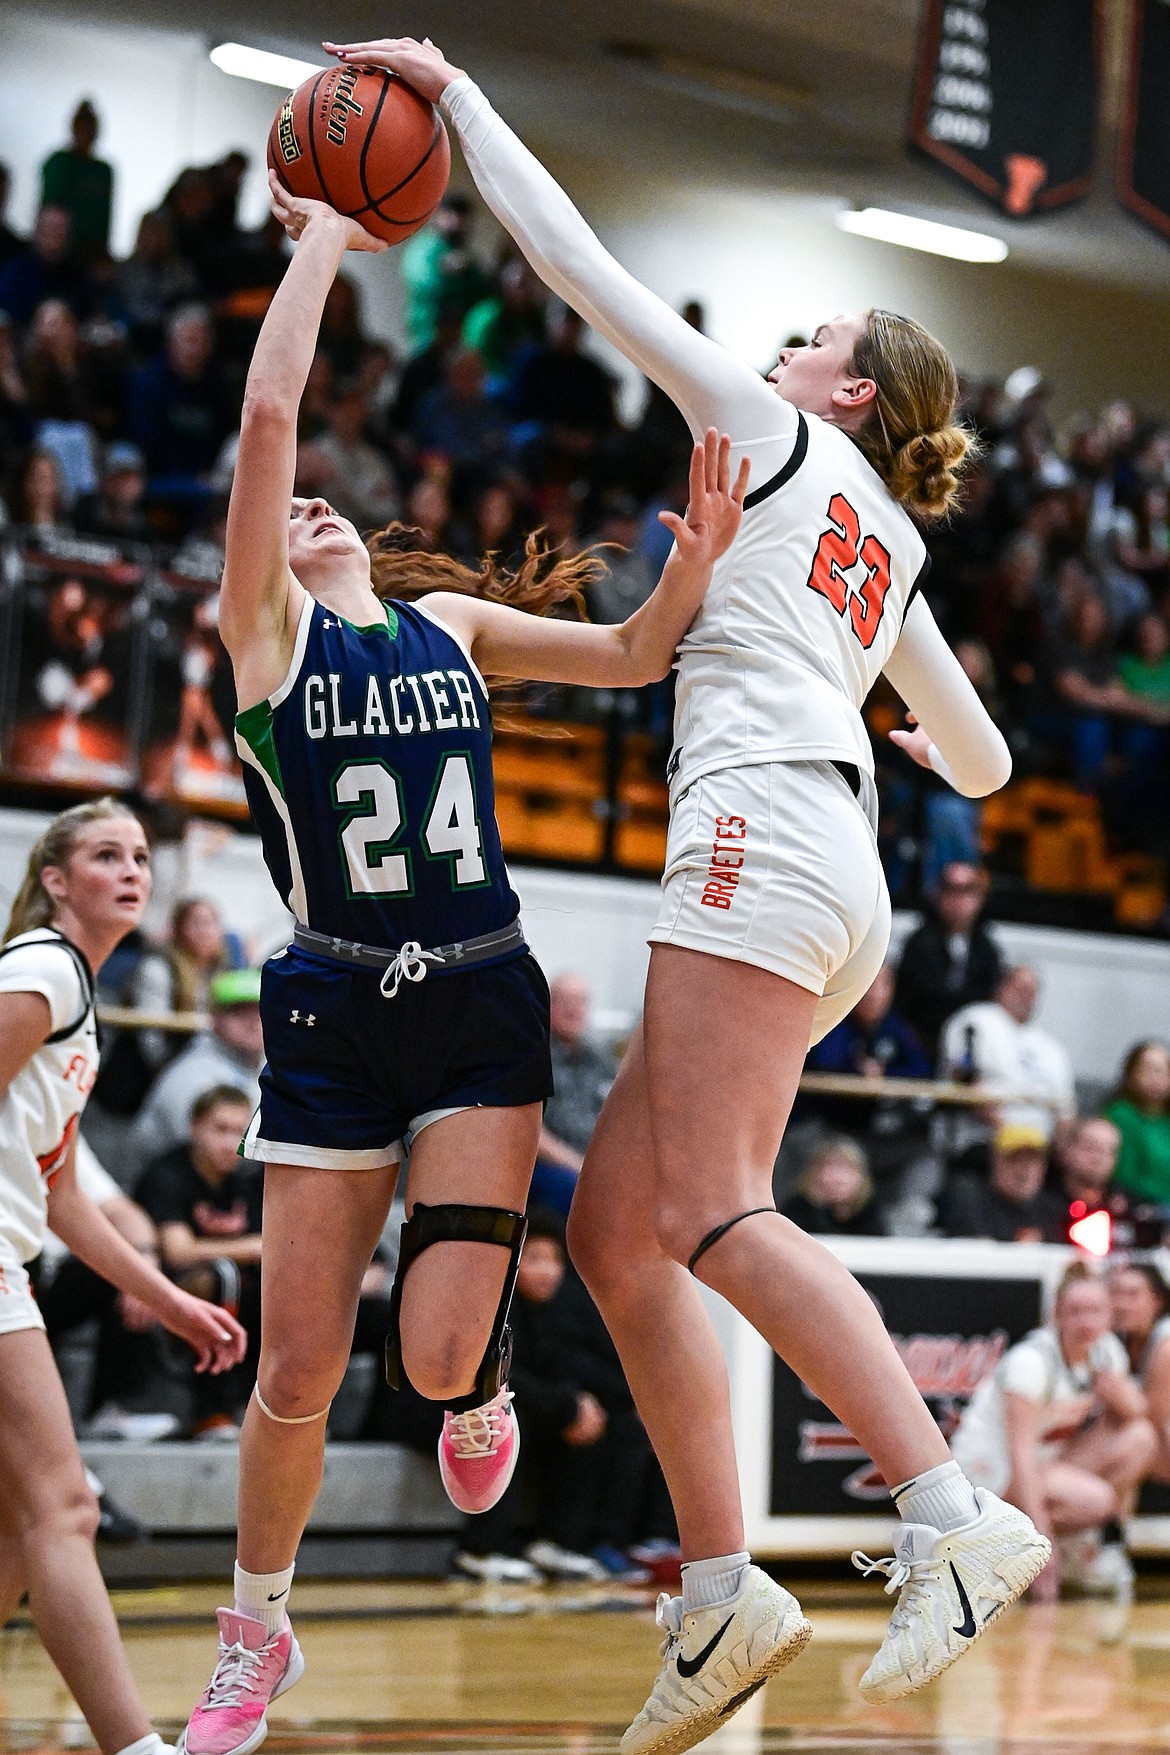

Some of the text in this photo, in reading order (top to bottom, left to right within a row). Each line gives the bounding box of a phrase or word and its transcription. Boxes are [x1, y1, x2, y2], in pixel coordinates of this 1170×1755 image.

[807, 492, 892, 650] 23
[305, 669, 480, 739] GLACIER
[332, 751, 491, 898] 24
